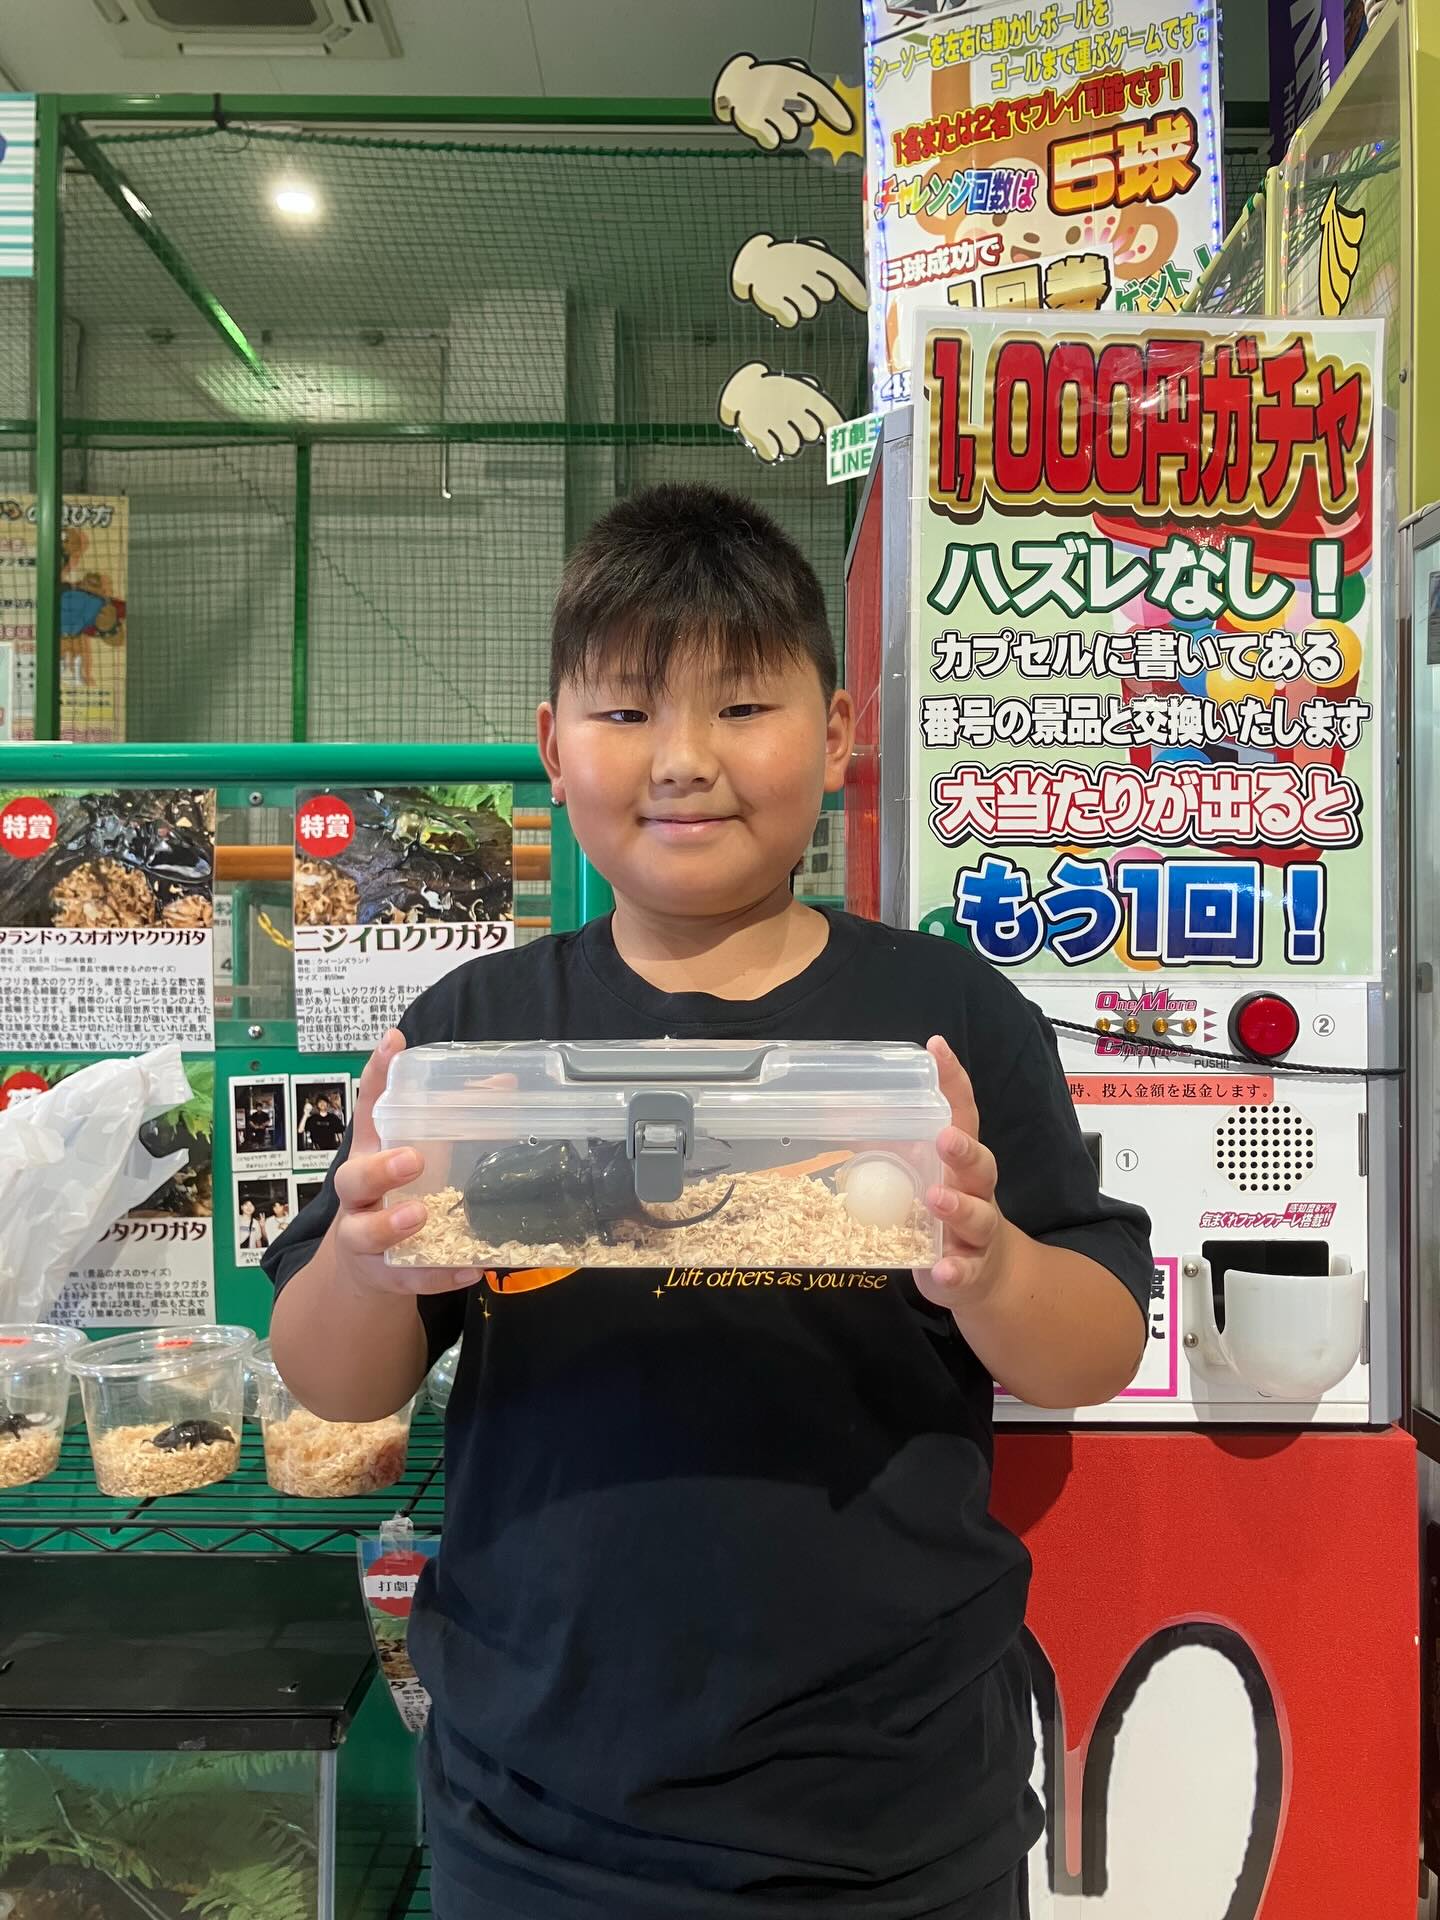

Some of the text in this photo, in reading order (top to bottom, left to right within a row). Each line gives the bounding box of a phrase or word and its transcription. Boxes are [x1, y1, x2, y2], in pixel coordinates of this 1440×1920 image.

[872, 1, 1110, 89] シーソーを左右に動かしボールを
[990, 15, 1207, 93] ゴールまで運ぶゲームです。
[1046, 107, 1201, 216] 5球
[875, 168, 1038, 220] チャレンジ回数は
[880, 234, 1003, 289] 5球成功で
[928, 330, 1370, 514] 1,000円ガチャ
[830, 447, 873, 479] LINE
[928, 533, 1344, 622] ハズレなし！
[931, 631, 1344, 683] カプセルに書いてある
[919, 694, 1374, 749] 番号の景品と交換いたします
[3, 815, 53, 840] 特賞
[300, 814, 350, 839] 特賞
[930, 761, 1364, 846] 大当たりが出ると
[295, 923, 509, 953] ニジイロクワガタ
[1193, 1058, 1230, 1069] PUSH!!
[1070, 1082, 1270, 1100] 時、投入金額を返金します。
[665, 1267, 888, 1291] Lift others as you rise
